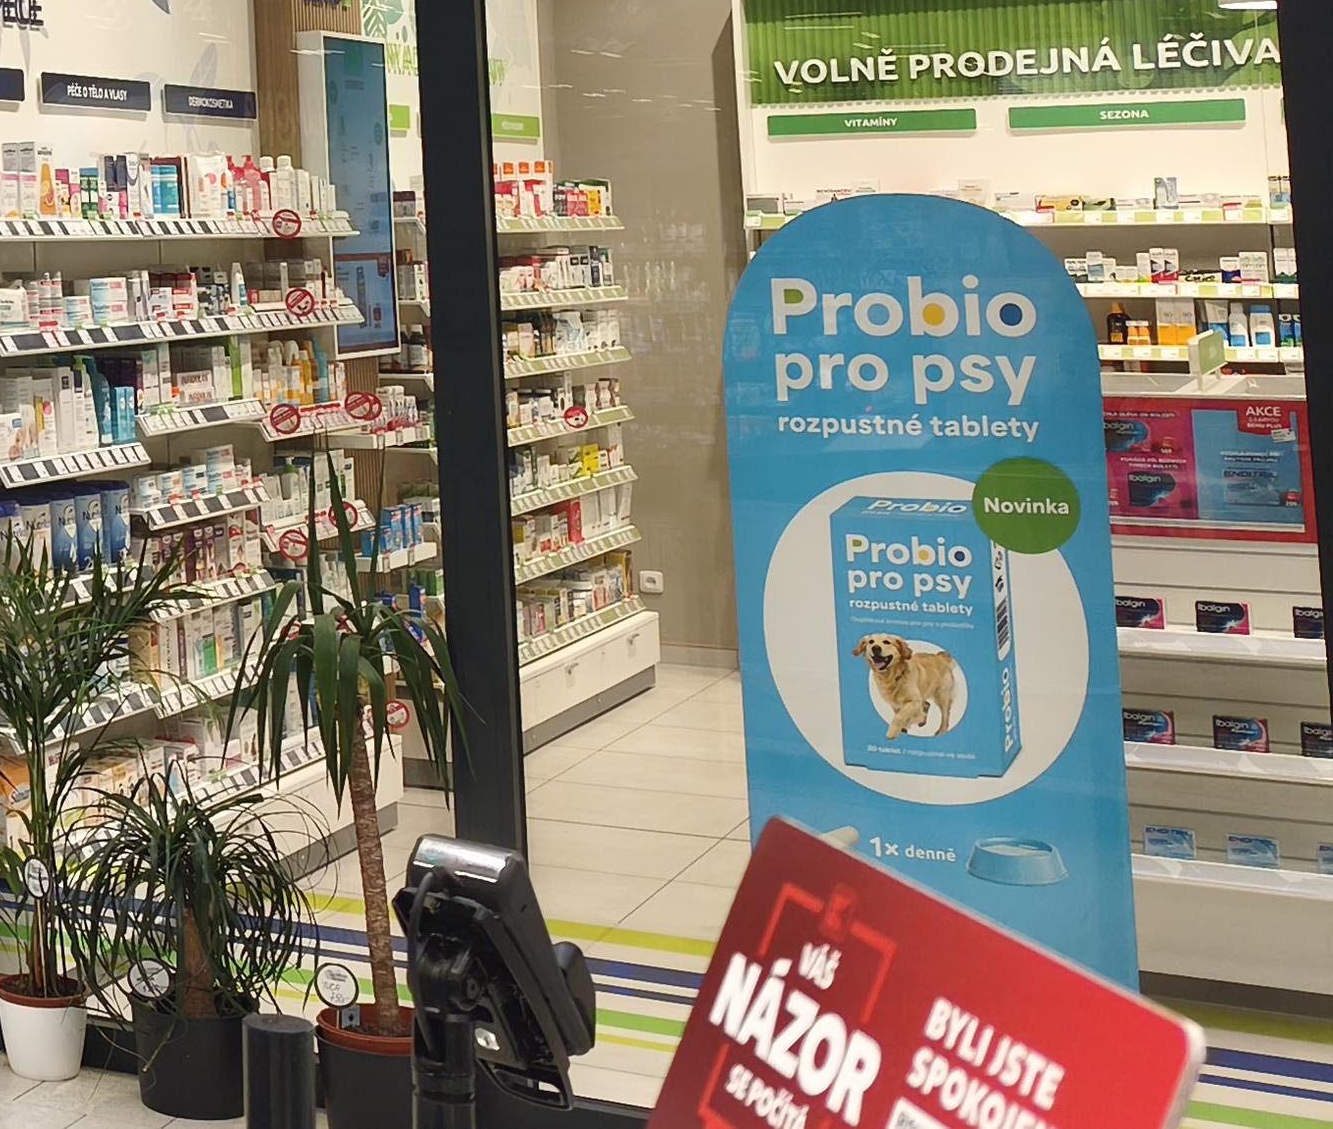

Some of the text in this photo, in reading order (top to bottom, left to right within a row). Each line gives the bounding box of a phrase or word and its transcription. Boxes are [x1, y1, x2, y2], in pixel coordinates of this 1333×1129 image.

[774, 33, 1282, 85] VOLNĚ PRODEJNÁ LÉČIVA
[844, 116, 898, 128] VITAMÍNY
[1099, 108, 1150, 120] SEZONA
[771, 274, 1037, 338] Probio
[775, 352, 1036, 406] pro psy
[1246, 406, 1282, 417] AKCE
[778, 413, 1040, 443] rozpustné tablety
[868, 500, 968, 513] Probio
[984, 497, 1070, 516] Novinka
[845, 533, 973, 568] Probio
[848, 569, 973, 600] pro psy
[849, 599, 974, 617] rozpustné tablety
[1198, 602, 1230, 613] Ibalgin
[1002, 668, 1014, 752] Probio
[1216, 719, 1248, 729] Ibalgin
[870, 837, 956, 861] 1x denně
[799, 942, 842, 989] VÁŠ
[709, 951, 882, 1127] NÁZOR
[924, 996, 1065, 1111] BYLI JSTE
[725, 1064, 754, 1101] SE
